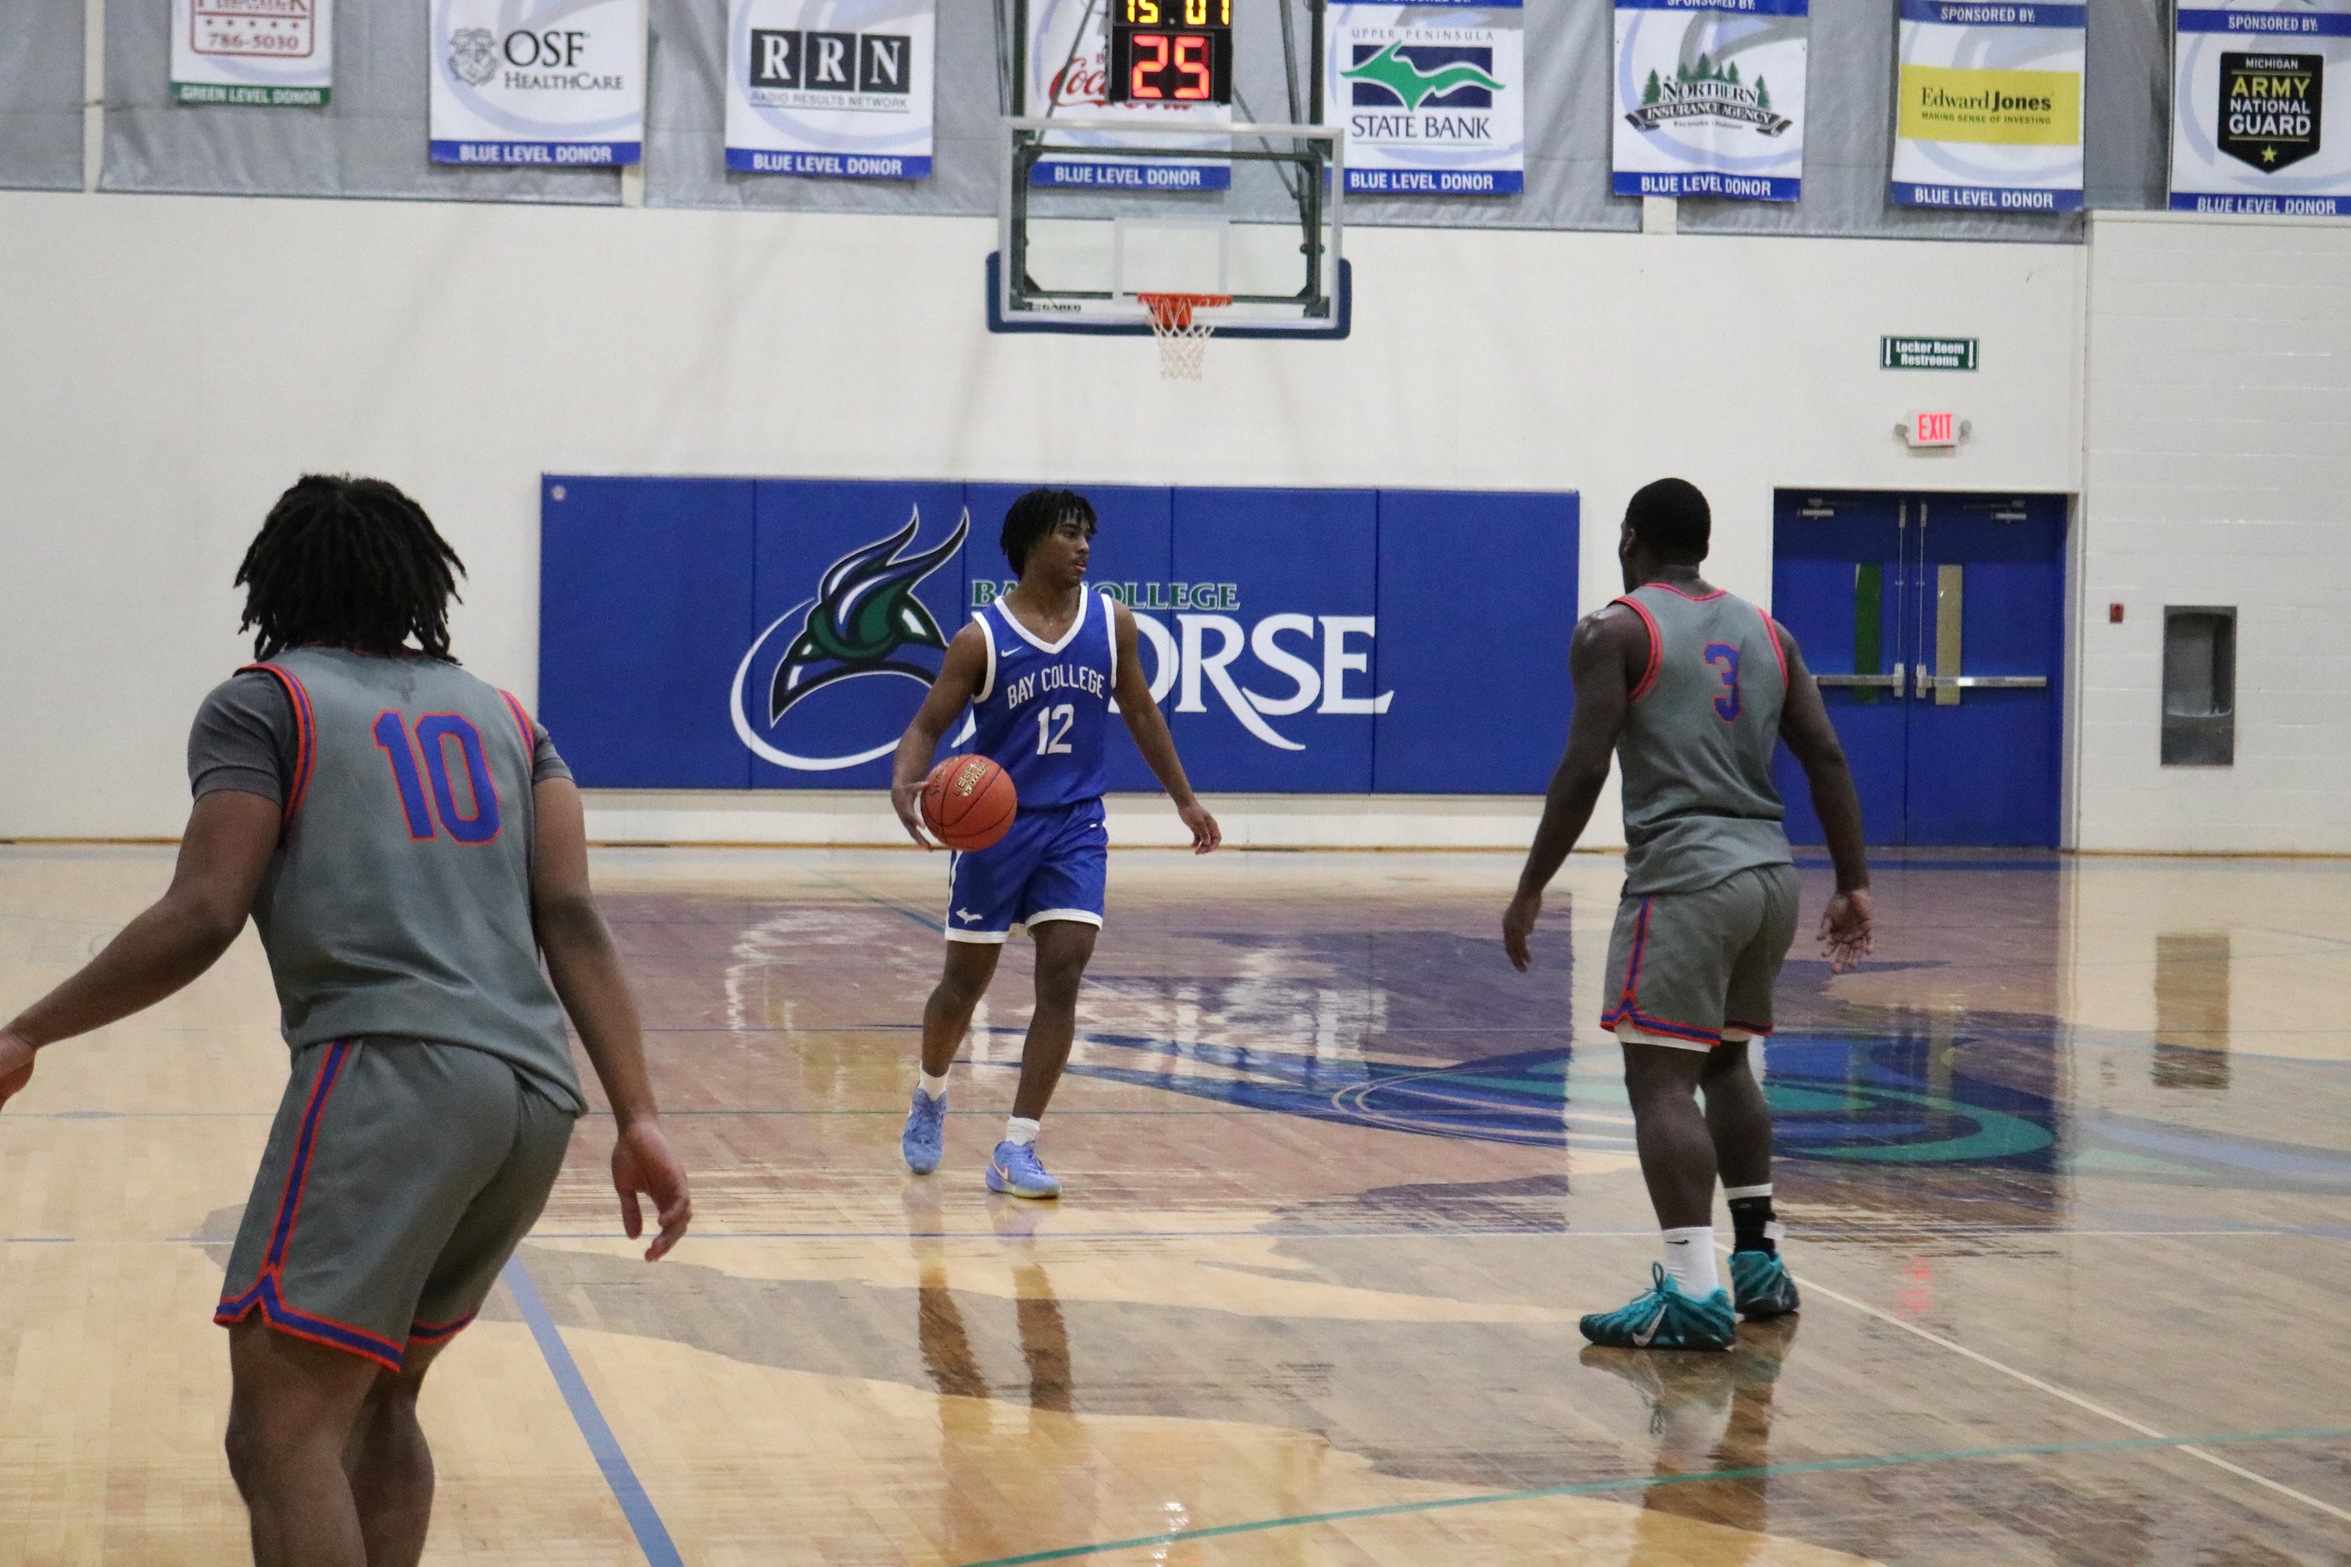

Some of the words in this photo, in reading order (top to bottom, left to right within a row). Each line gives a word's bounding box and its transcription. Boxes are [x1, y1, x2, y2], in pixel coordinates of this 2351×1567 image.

[1941, 7, 2015, 22] SPONSORED
[2019, 8, 2035, 23] BY:
[2228, 15, 2298, 30] SPONSORED
[2302, 18, 2318, 31] BY:
[1352, 29, 1395, 39] UPPER
[1406, 30, 1493, 40] PENINSULA
[504, 30, 584, 67] OSF
[1132, 34, 1210, 99] 25
[2245, 58, 2298, 70] MICHIGAN
[2232, 76, 2310, 98] ARMY
[849, 97, 908, 109] NETWORK
[1921, 87, 1989, 110] Edward
[1991, 91, 2052, 112] Jones
[2230, 98, 2310, 114] NATIONAL
[1648, 102, 1720, 121] INSURANCE
[1722, 105, 1772, 126] AGENCY
[1922, 112, 1954, 122] MAKING
[1958, 114, 1985, 123] SENSE
[1990, 115, 2000, 123] OF
[2004, 116, 2051, 125] INVESTING
[1352, 115, 1417, 138] STATE
[1425, 117, 1491, 139] BANK
[2229, 115, 2311, 136] GUARD
[459, 145, 500, 162] BLUE
[503, 146, 549, 162] LEVEL
[555, 146, 612, 162] DONOR
[753, 153, 793, 170] BLUE
[796, 157, 843, 174] LEVEL
[847, 159, 902, 176] DONOR
[1054, 166, 1093, 183] BLUE
[1096, 168, 1143, 184] LEVEL
[1147, 169, 1201, 186] DONOR
[1351, 172, 1388, 189] BLUE
[1392, 173, 1437, 189] LEVEL
[1441, 174, 1494, 190] DONOR
[1641, 177, 1679, 193] BLUE
[1683, 177, 1723, 193] LEVEL
[1725, 181, 1772, 197] DONOR
[1914, 187, 1950, 203] BLUE
[1954, 189, 1997, 205] LEVEL
[2001, 192, 2054, 208] DONOR
[2197, 197, 2233, 213] BLUE
[2237, 199, 2280, 214] LEVEL
[2285, 200, 2336, 215] DONOR
[1896, 341, 1932, 354] Locker
[1934, 341, 1964, 355] Room
[1901, 354, 1959, 367] Restrooms
[1918, 413, 1953, 441] EXIT
[1007, 672, 1036, 710] BAY
[1041, 663, 1105, 700] COLLEGE
[1703, 641, 1743, 724] 3
[1036, 703, 1075, 756] 12
[370, 709, 502, 846] 10
